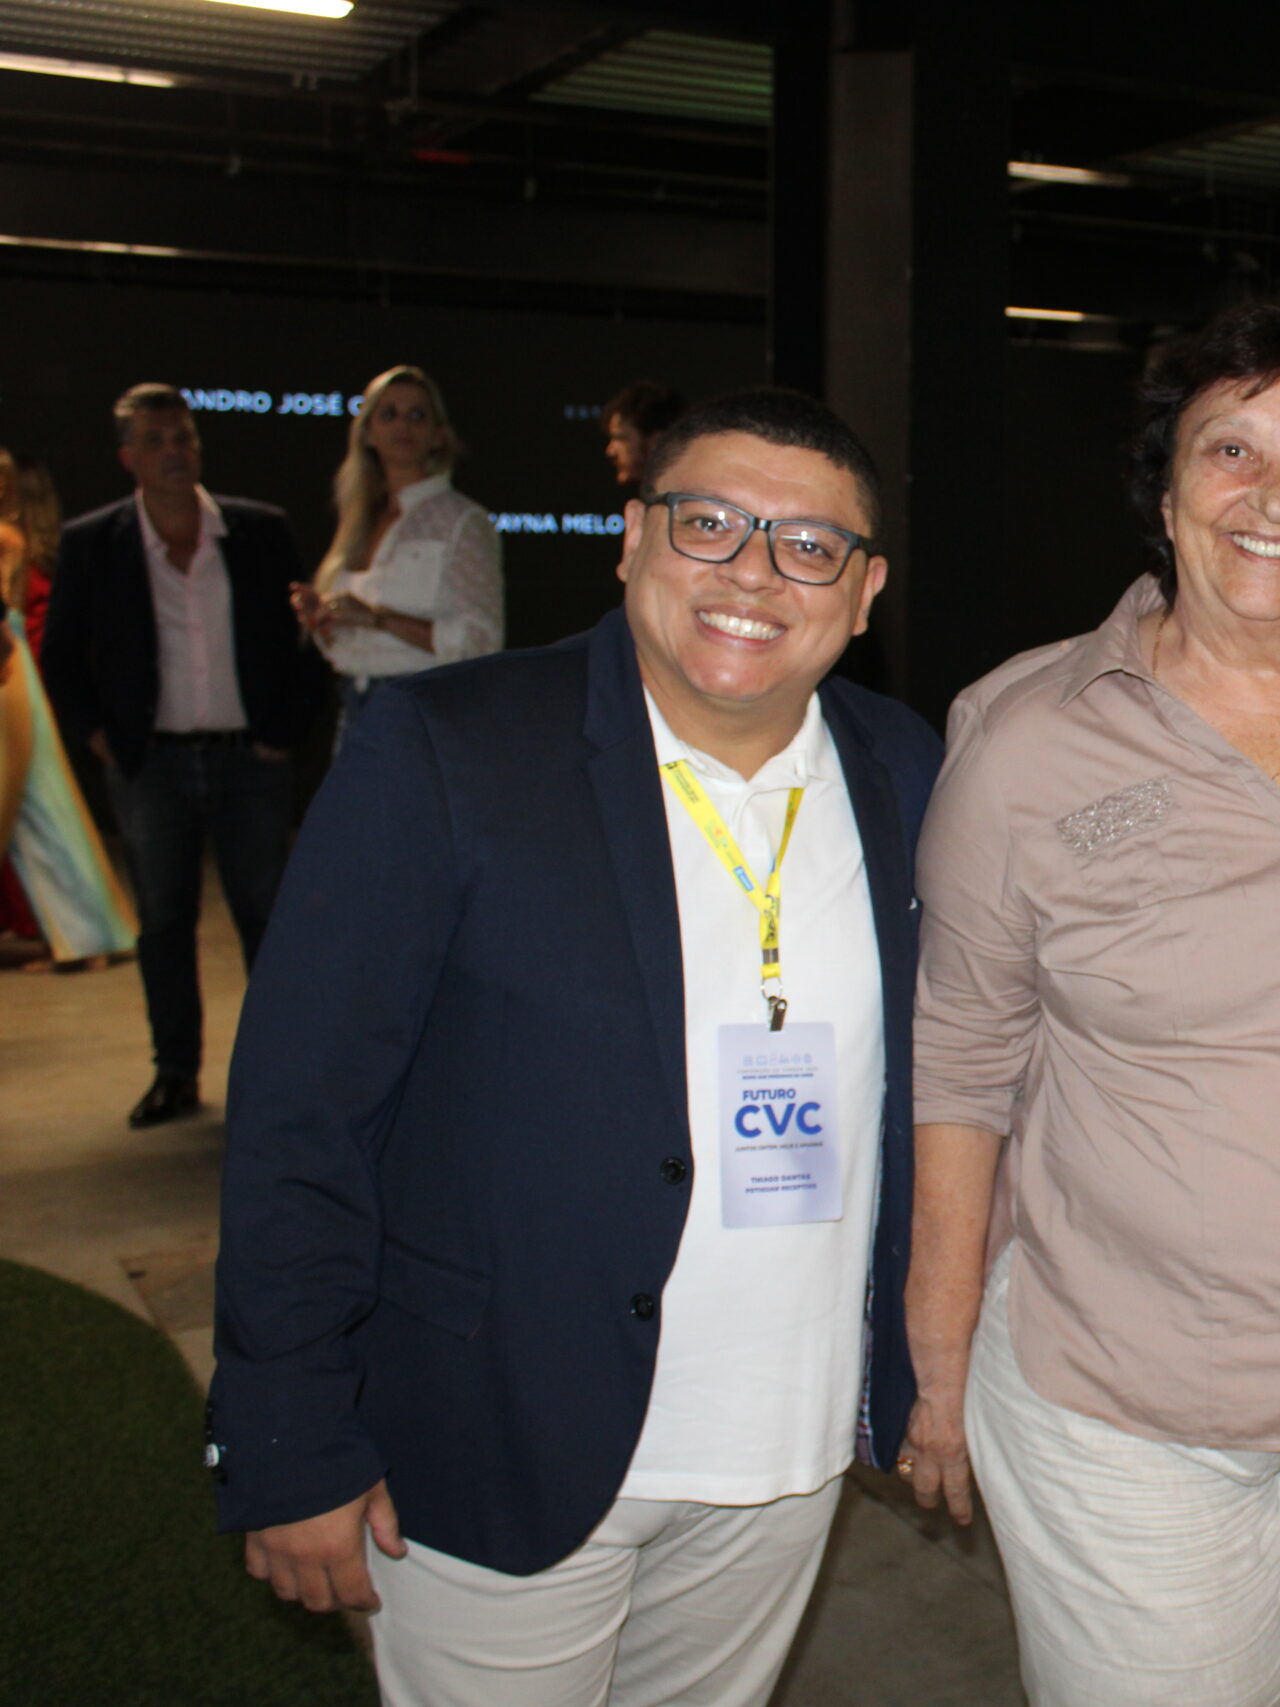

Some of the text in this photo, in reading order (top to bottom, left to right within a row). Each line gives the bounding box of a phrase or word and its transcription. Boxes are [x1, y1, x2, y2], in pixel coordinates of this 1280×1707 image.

[277, 391, 344, 416] JOSÉ
[562, 513, 626, 535] MELO
[743, 1088, 796, 1101] FUTURO
[734, 1102, 823, 1138] CVC
